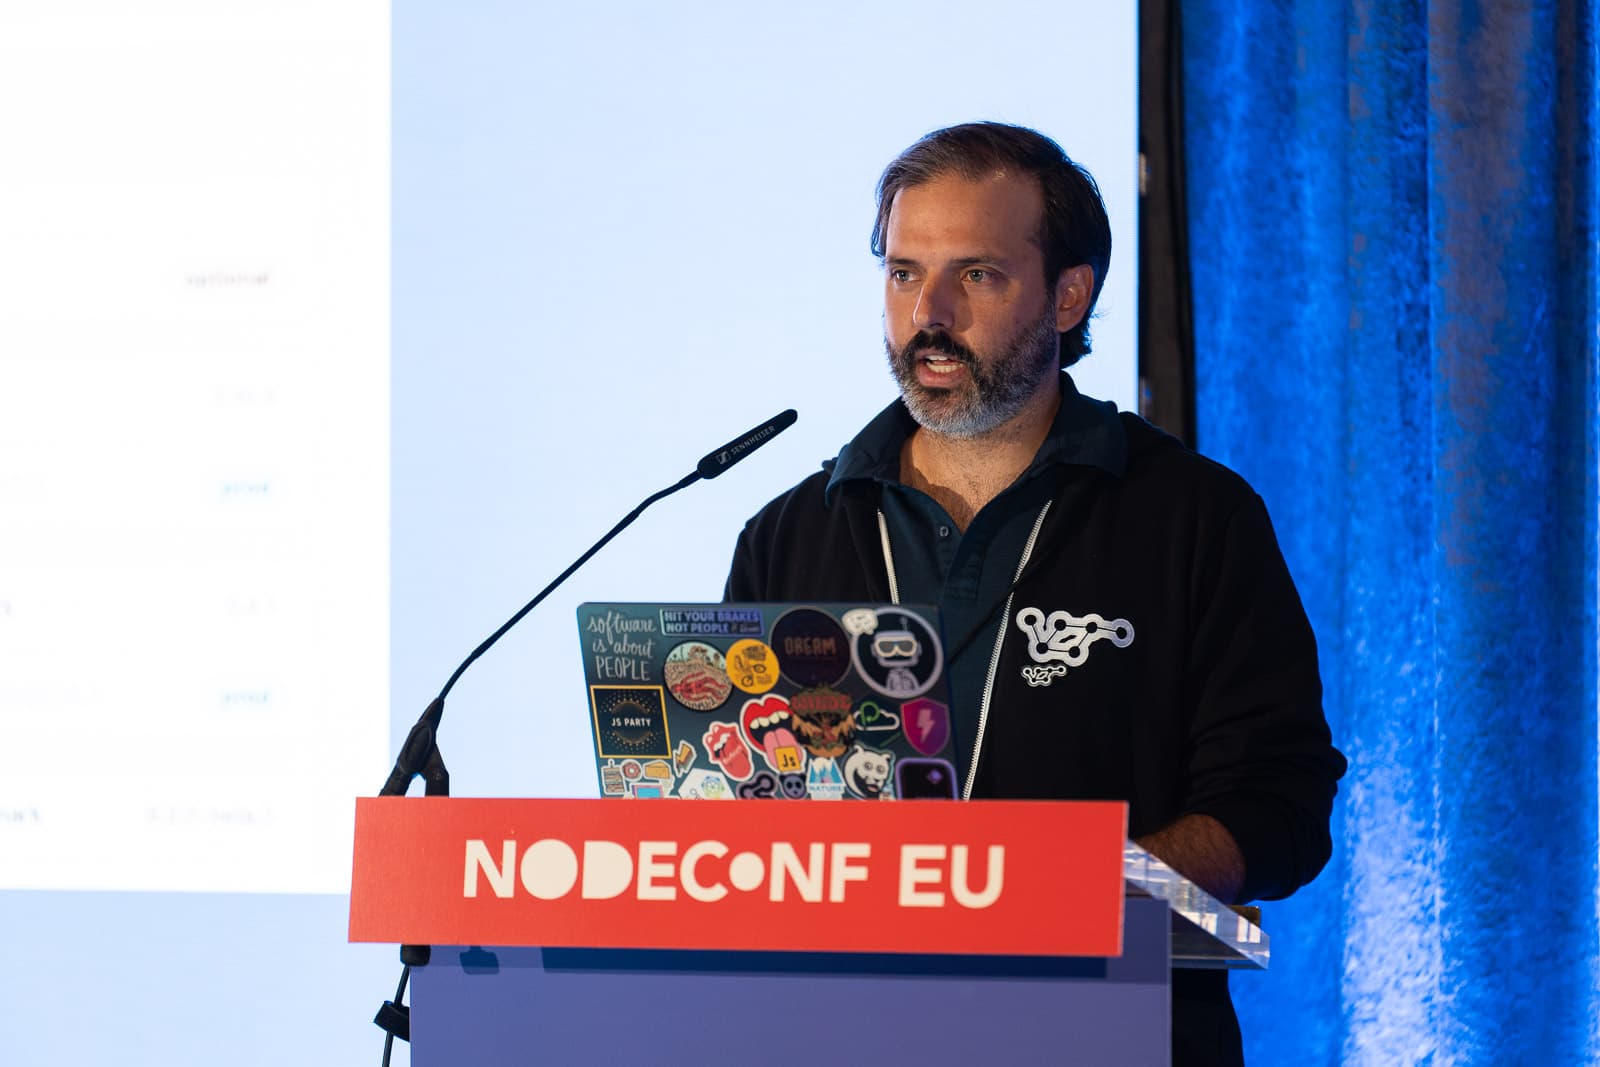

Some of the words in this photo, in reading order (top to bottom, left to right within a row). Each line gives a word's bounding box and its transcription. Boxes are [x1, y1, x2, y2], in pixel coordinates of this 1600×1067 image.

[730, 425, 776, 455] SENNHEISER
[587, 610, 657, 645] software
[664, 611, 684, 622] HIT
[685, 611, 715, 622] YOUR
[717, 611, 760, 622] BRAKES
[665, 622, 689, 633] NOT
[690, 622, 729, 633] PEOPLE
[592, 639, 608, 653] is
[613, 634, 656, 659] about
[784, 637, 837, 655] DREAM
[595, 655, 651, 682] PEOPLE
[611, 717, 622, 727] JS
[624, 717, 652, 727] PARTY
[898, 844, 1005, 909] EU
